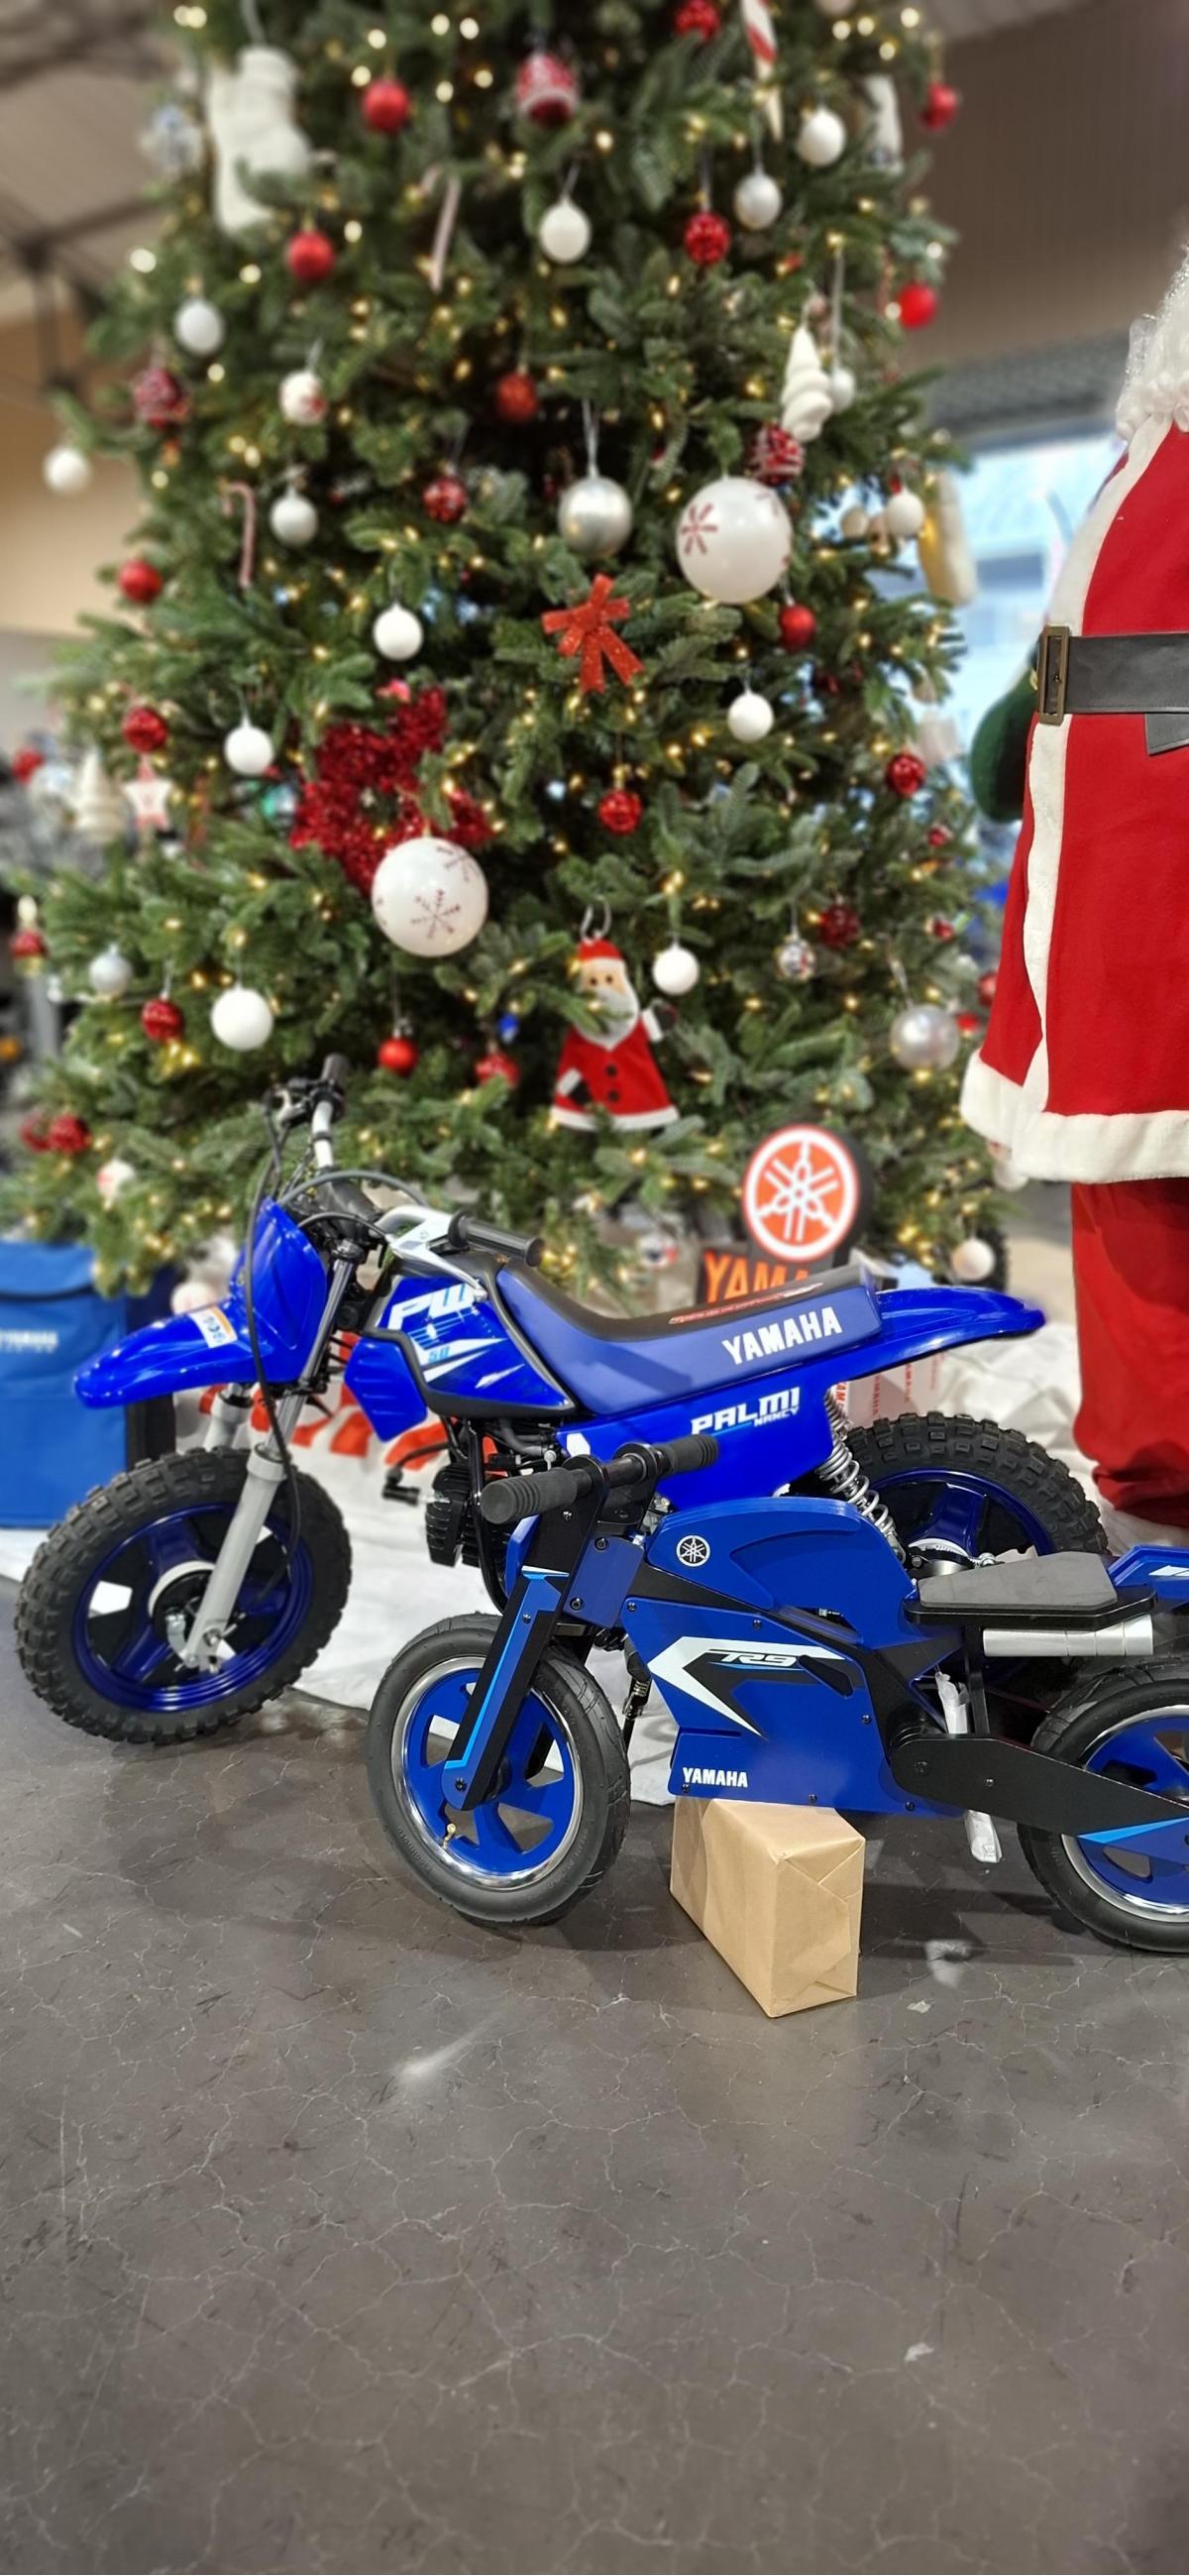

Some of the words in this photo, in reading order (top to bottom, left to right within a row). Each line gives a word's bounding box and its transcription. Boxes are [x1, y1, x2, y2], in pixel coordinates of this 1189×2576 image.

[387, 1283, 478, 1330] PW
[722, 1306, 843, 1365] YAMAHA
[691, 1387, 801, 1435] PALMI
[754, 1406, 801, 1427] NANCY
[682, 1767, 749, 1788] YAMAHA
